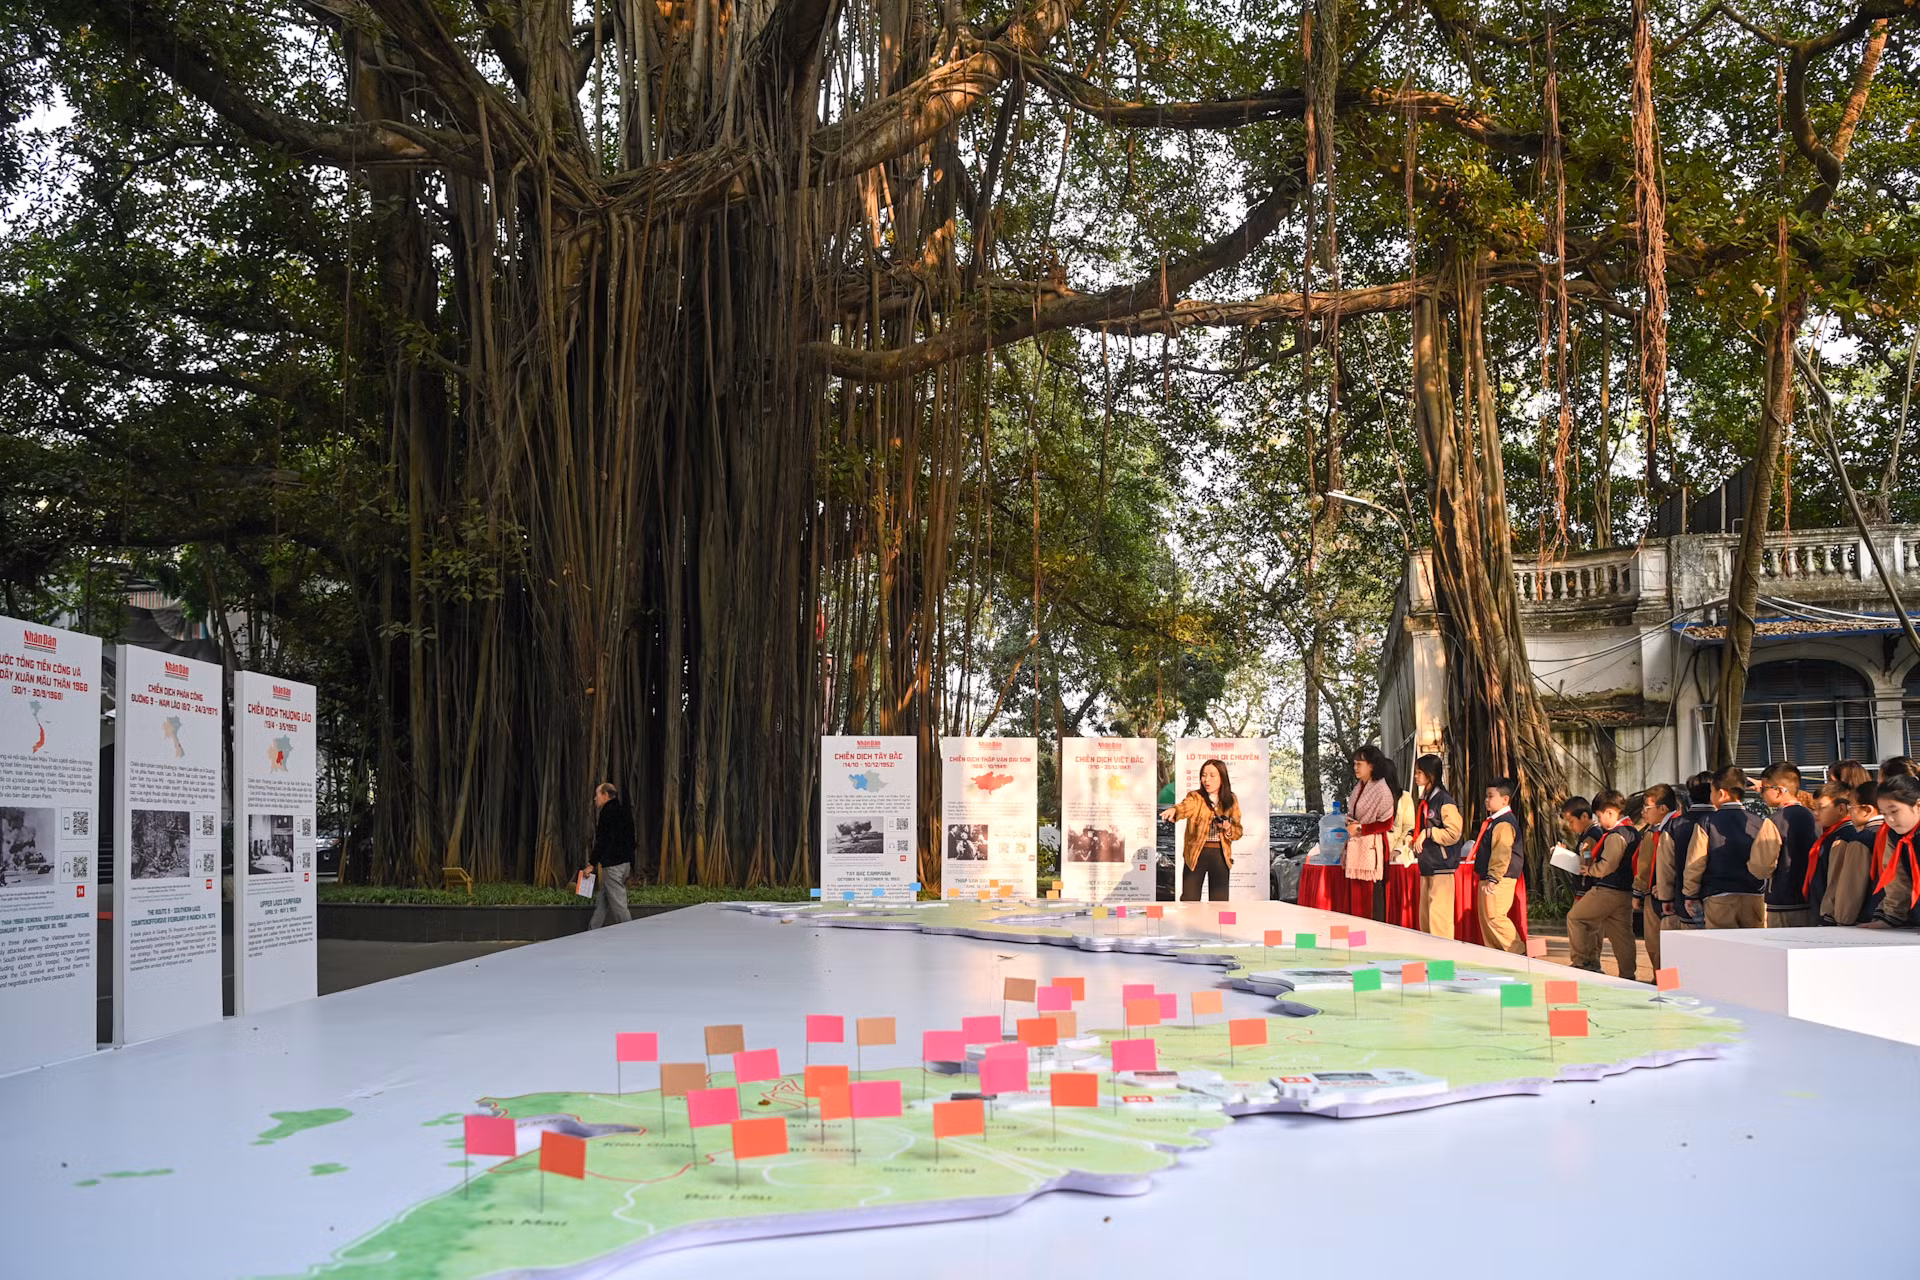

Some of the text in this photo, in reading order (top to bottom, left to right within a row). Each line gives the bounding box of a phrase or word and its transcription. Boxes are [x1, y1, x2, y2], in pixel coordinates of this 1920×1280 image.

[24, 630, 56, 647] Nhân Dân
[16, 654, 34, 669] TỔNG
[36, 658, 51, 672] TIẾN
[53, 663, 70, 675] CÔNG
[72, 667, 81, 677] VÀ
[165, 661, 189, 675] Nhân Dân
[15, 672, 34, 683] XUÂN
[36, 675, 51, 687] MẬU
[53, 678, 70, 689] THÂN
[73, 682, 88, 692] 1968
[12, 685, 26, 695] (30/1
[33, 689, 63, 700] 30/9/1968)
[148, 683, 163, 694] CHIẾN
[164, 687, 175, 696] DỊCH
[190, 691, 203, 701] CÔNG
[159, 699, 170, 707] NAM
[171, 700, 180, 710] LÀO
[266, 706, 278, 718] DỊCH
[280, 709, 300, 721] THƯỢNG
[302, 711, 312, 722] LÀO
[835, 751, 854, 760] CHIẾN
[874, 752, 887, 760] TÂY
[889, 751, 903, 760] BẮC
